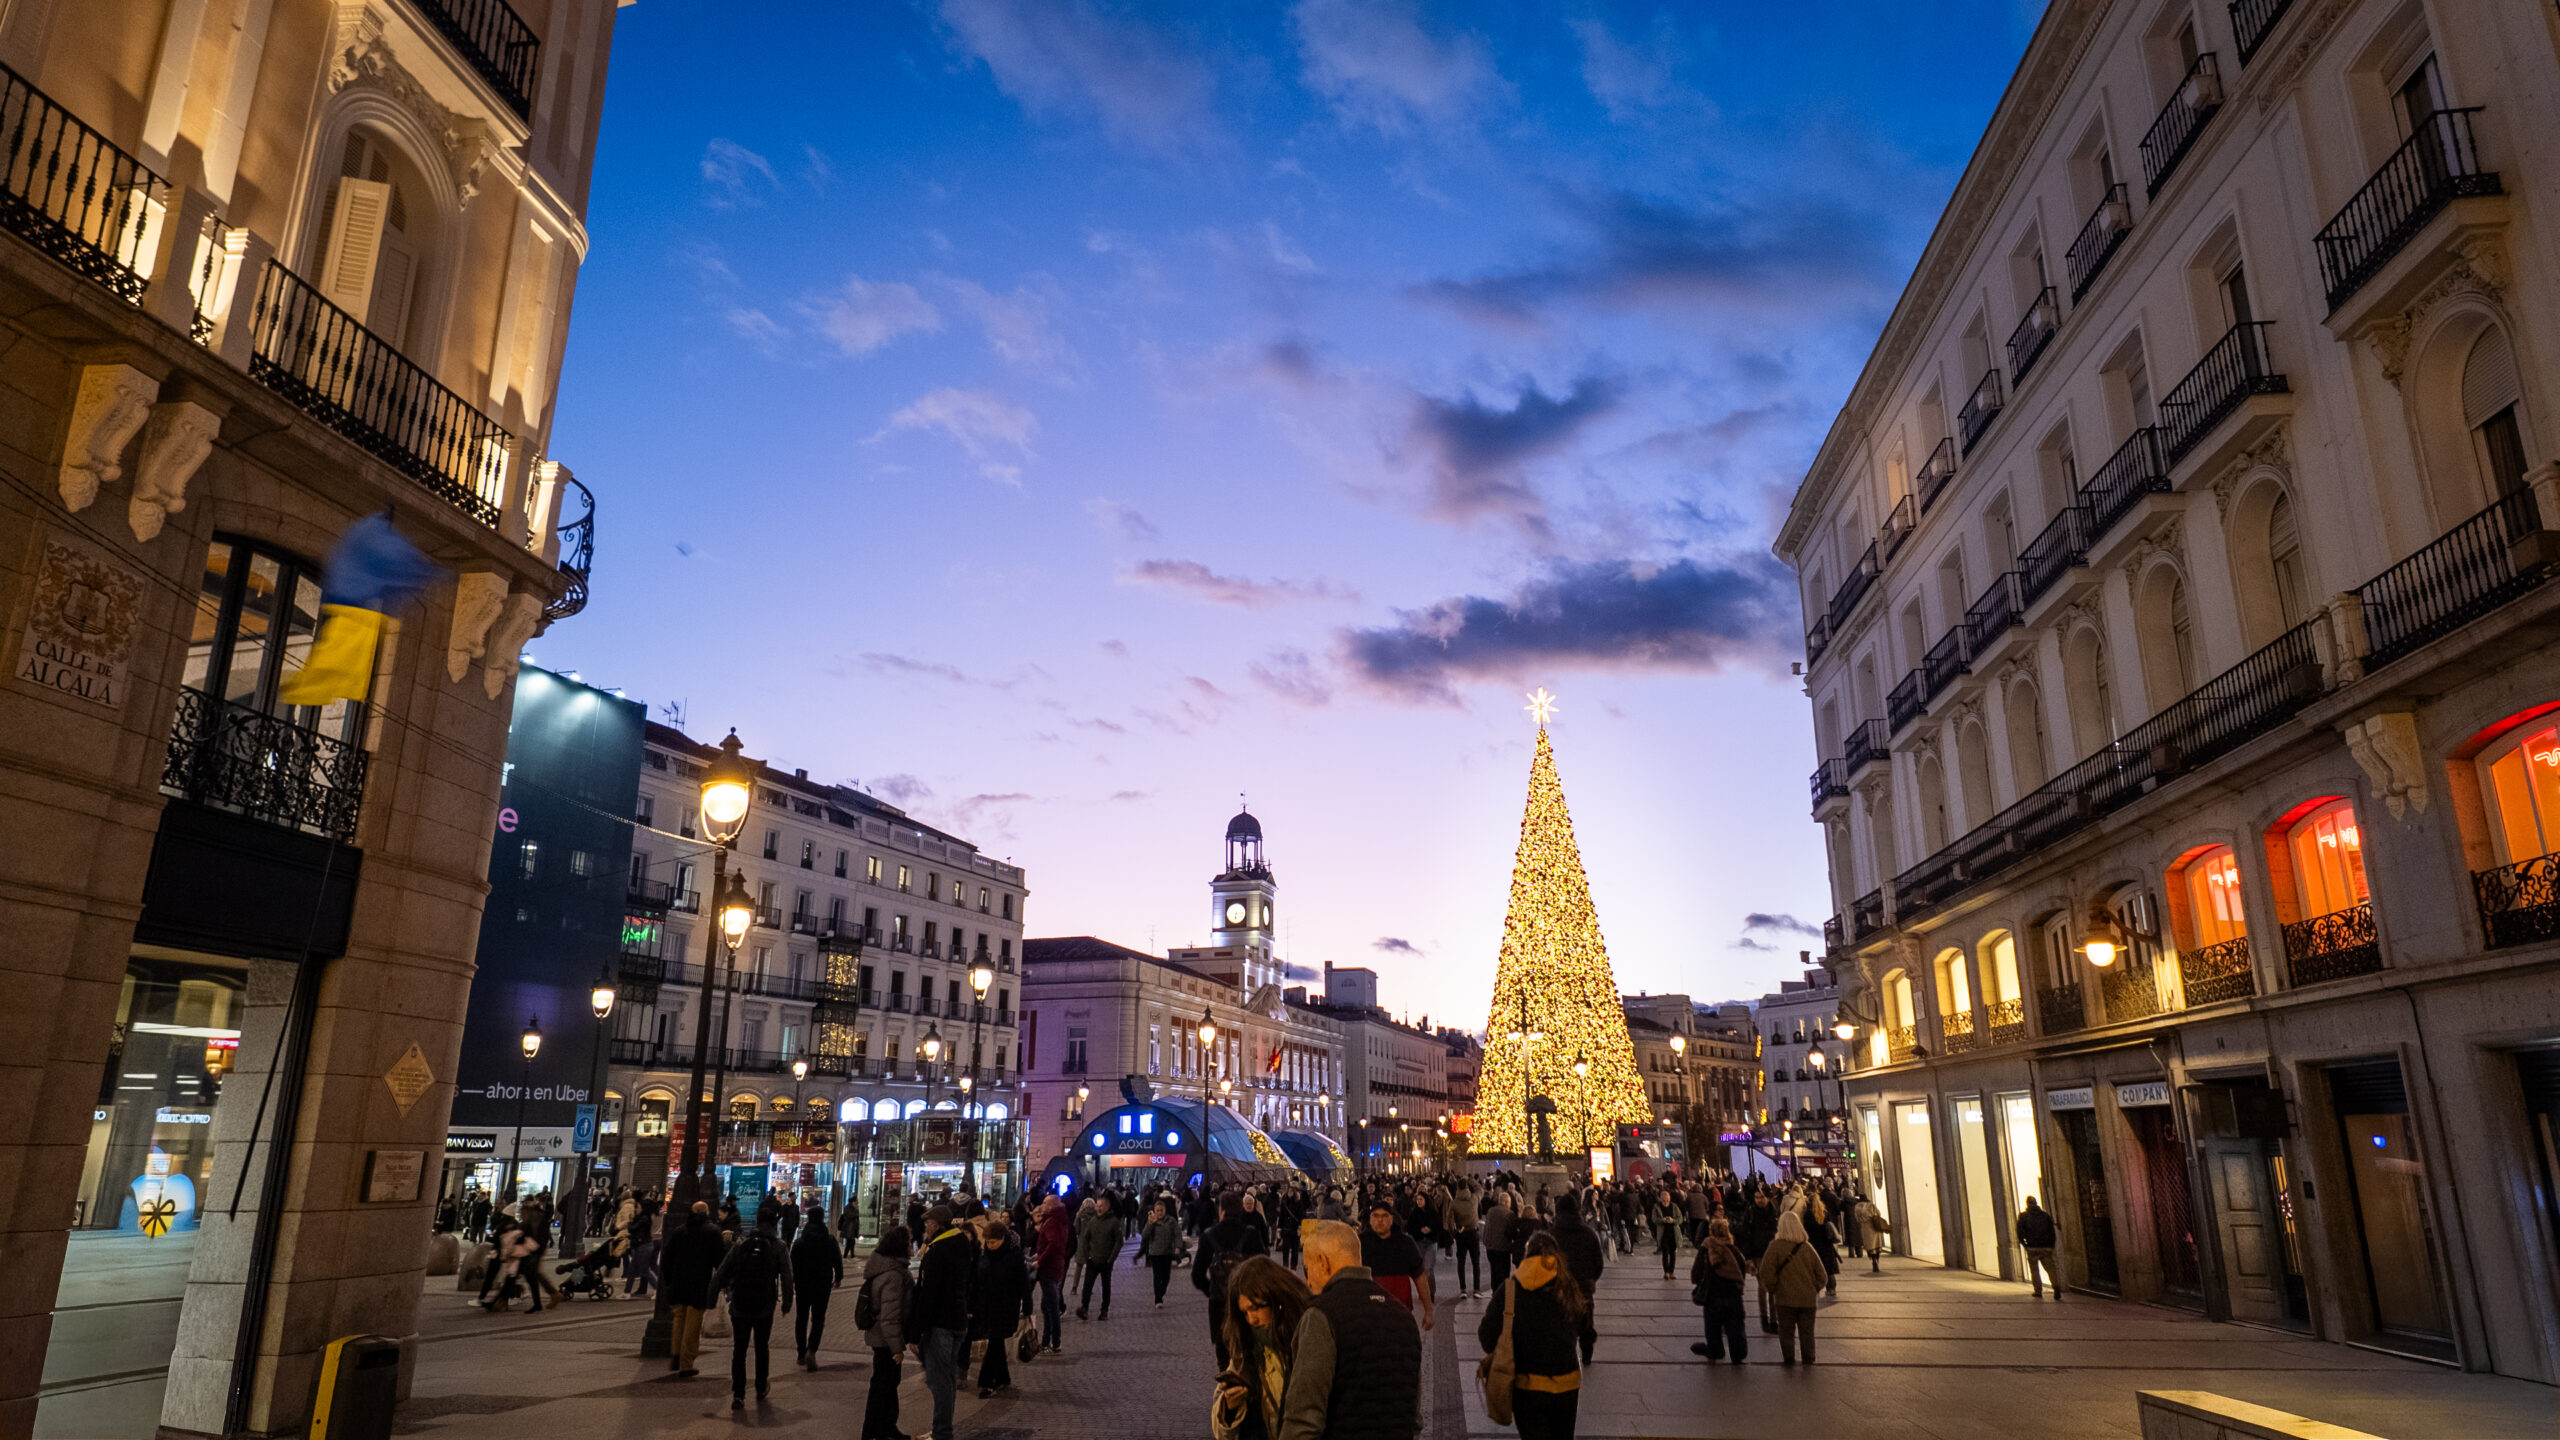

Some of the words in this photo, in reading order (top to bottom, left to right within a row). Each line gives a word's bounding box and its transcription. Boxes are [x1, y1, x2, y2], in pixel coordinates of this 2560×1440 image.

[35, 640, 92, 672] CALLE
[96, 662, 113, 678] DE
[21, 657, 112, 704] ALCALÁ
[208, 1039, 240, 1048] VIPS
[486, 1081, 530, 1100] ahora
[534, 1087, 552, 1101] en
[556, 1084, 590, 1102] Uber
[2122, 1086, 2168, 1102] COMPANY
[510, 1135, 547, 1147] Crrefour
[774, 1131, 789, 1139] BIG
[466, 1138, 494, 1148] VISION
[1151, 1156, 1168, 1164] SOL
